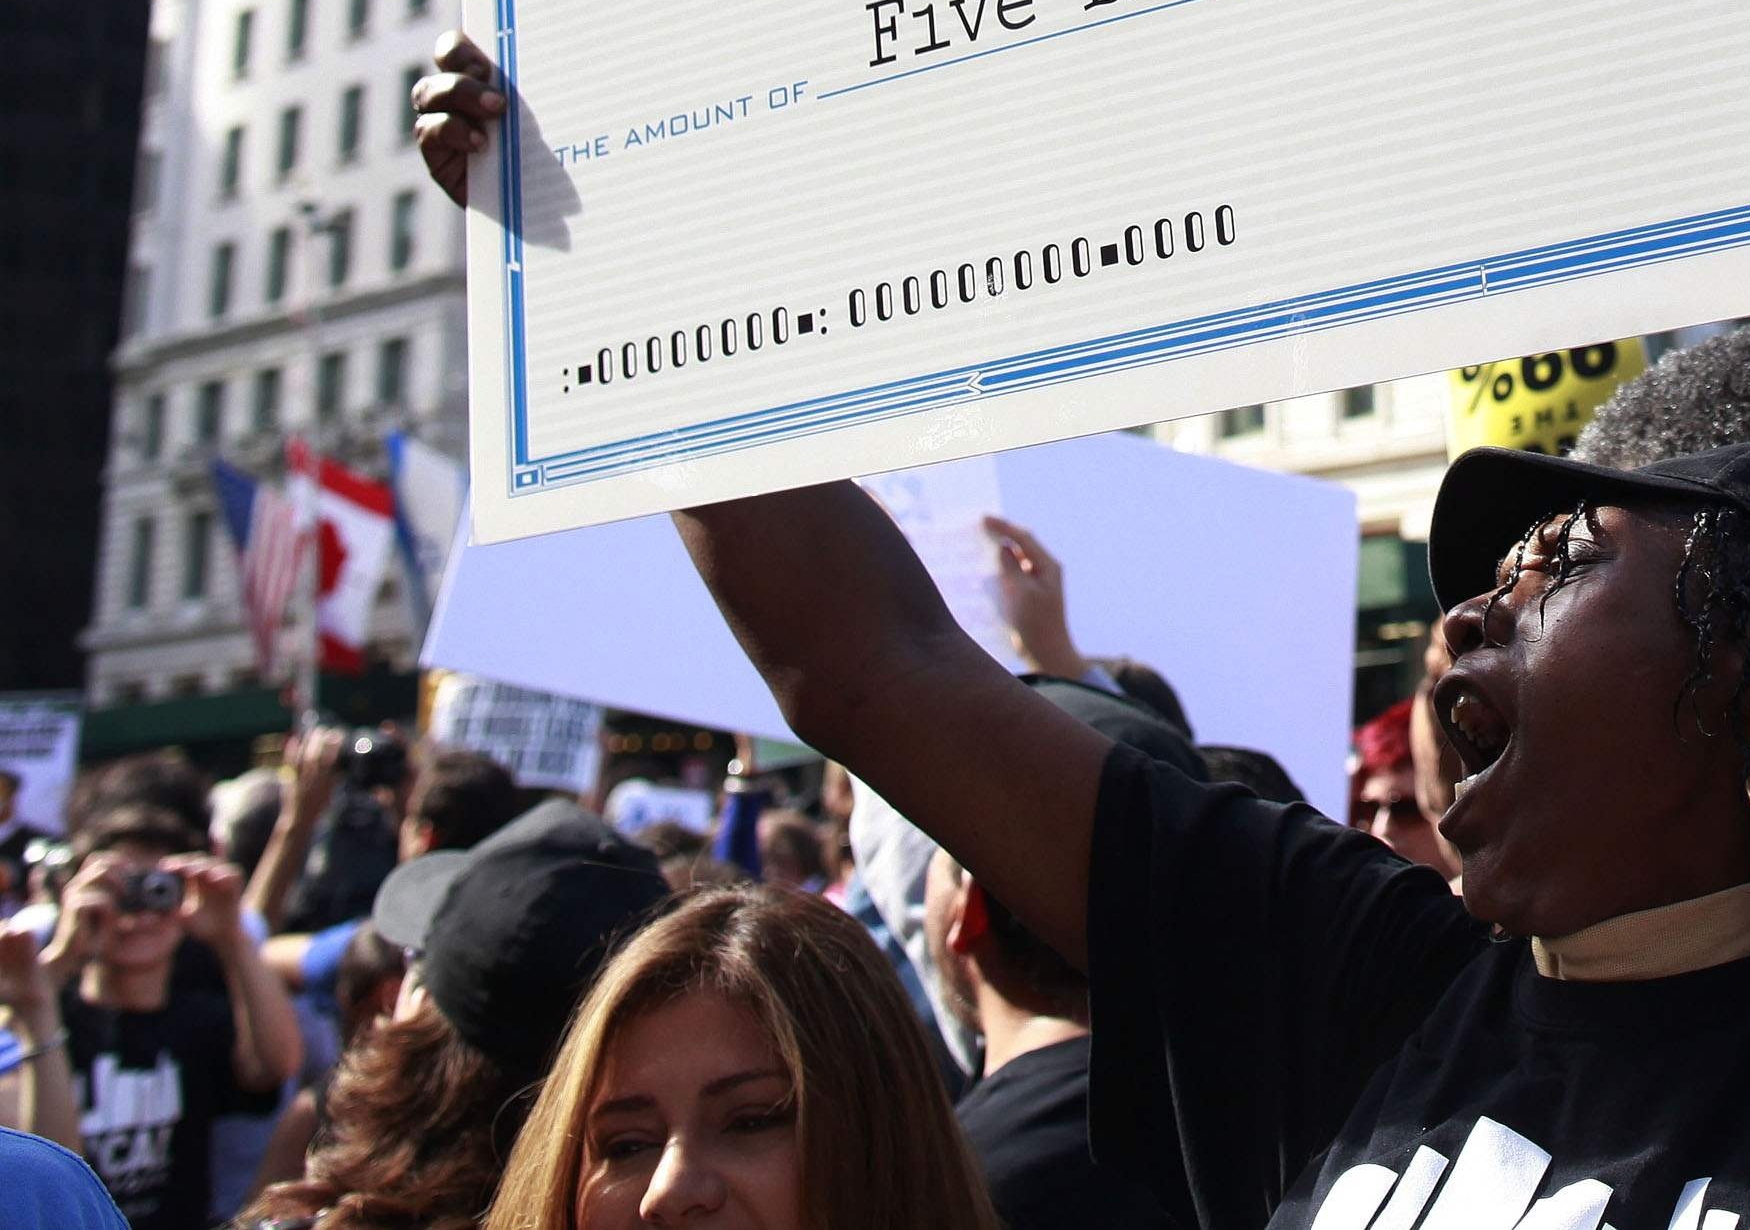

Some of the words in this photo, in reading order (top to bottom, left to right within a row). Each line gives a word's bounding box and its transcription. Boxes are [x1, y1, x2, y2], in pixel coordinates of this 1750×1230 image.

[554, 134, 610, 168] THE
[623, 95, 753, 149] AMOUNT
[768, 79, 809, 110] OF
